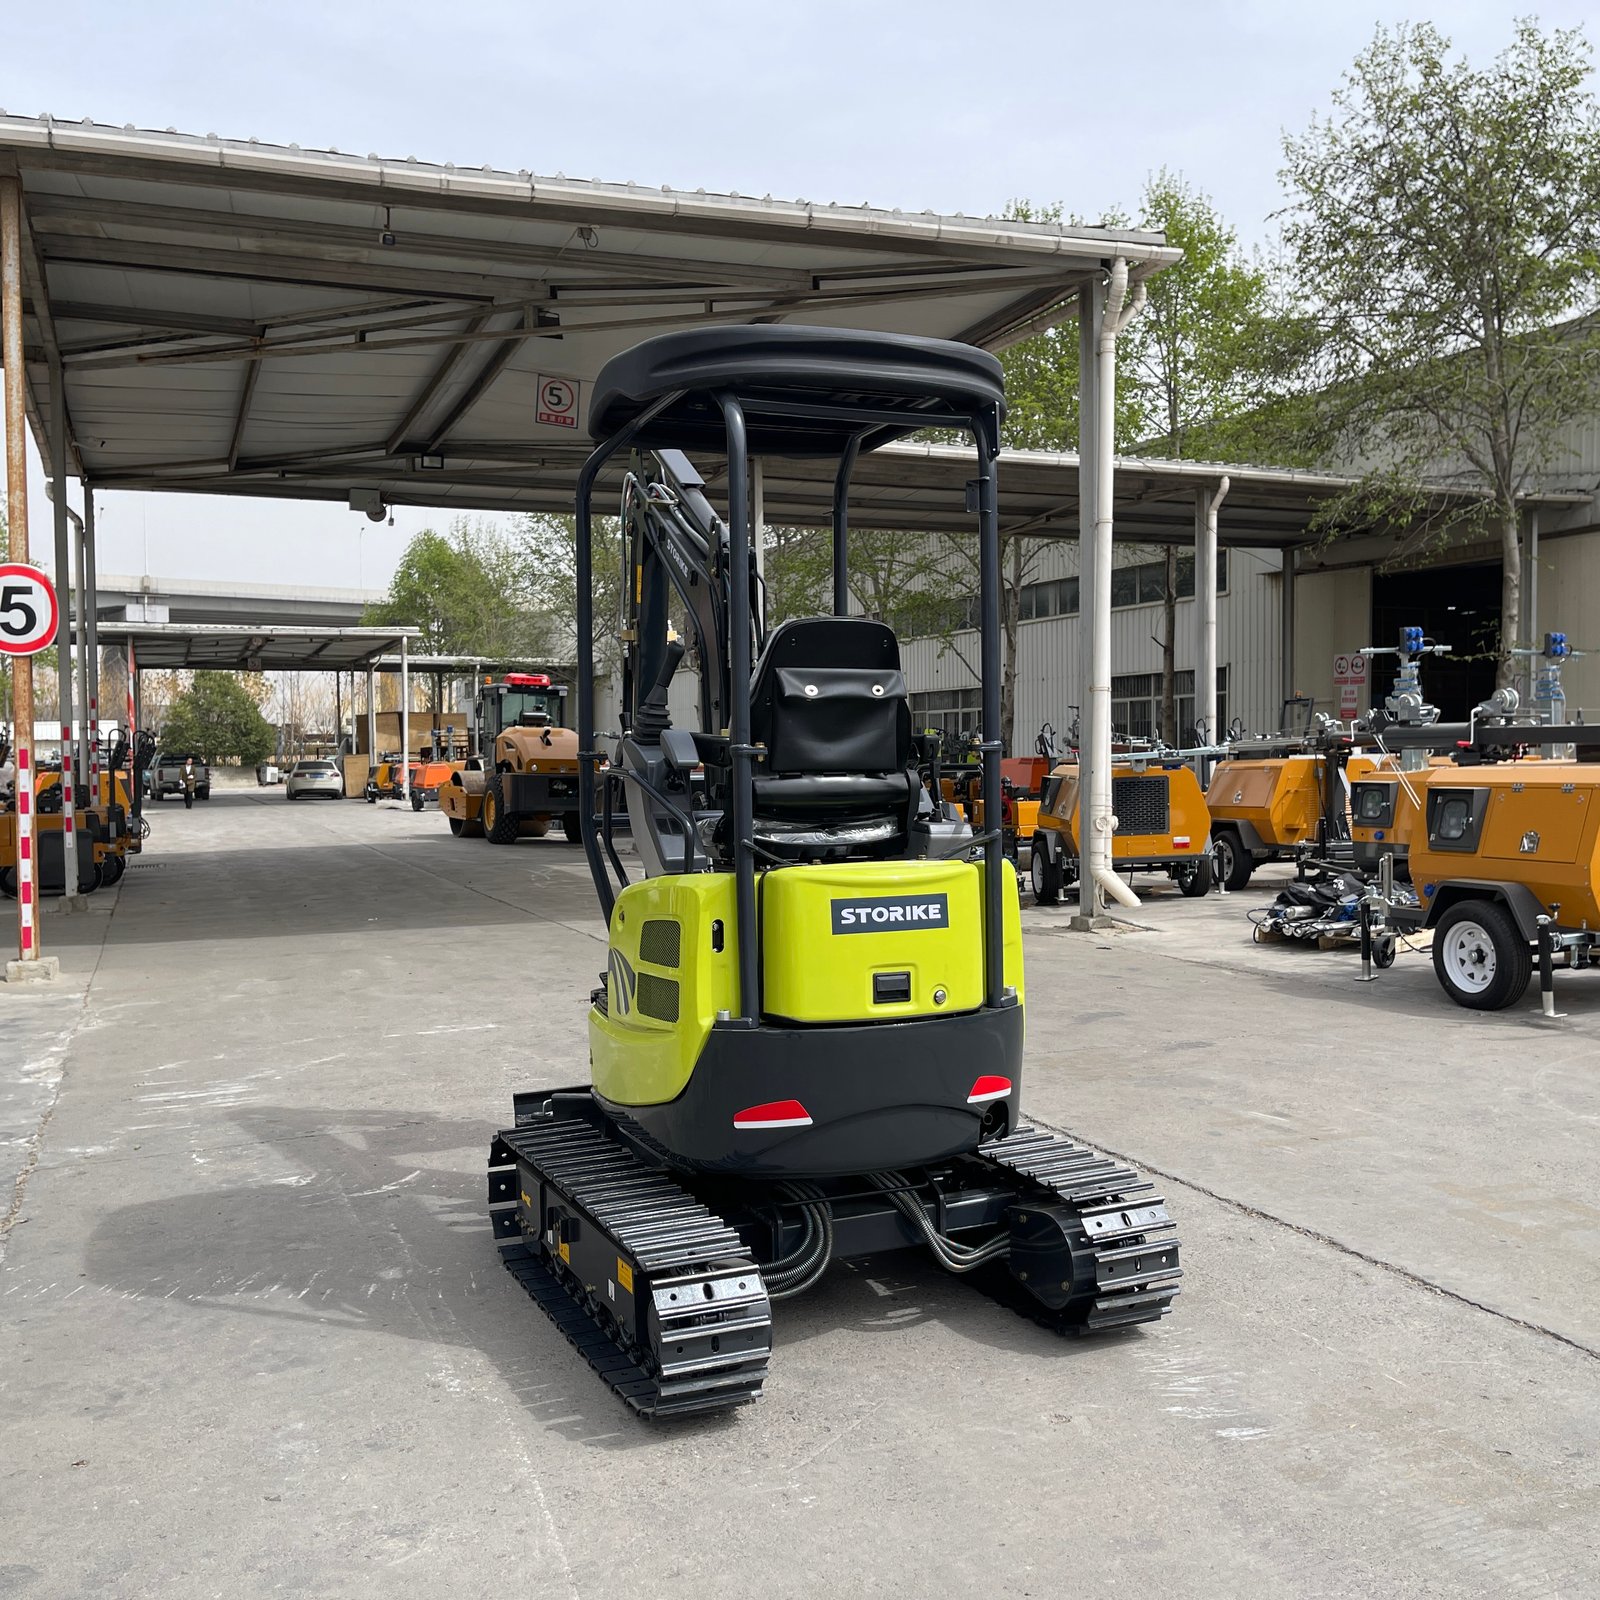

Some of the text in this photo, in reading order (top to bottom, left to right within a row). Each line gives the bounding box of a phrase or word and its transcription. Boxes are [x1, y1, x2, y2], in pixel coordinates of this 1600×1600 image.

[548, 386, 562, 406] 5
[0, 586, 37, 636] 5
[841, 903, 942, 925] STORIKE
